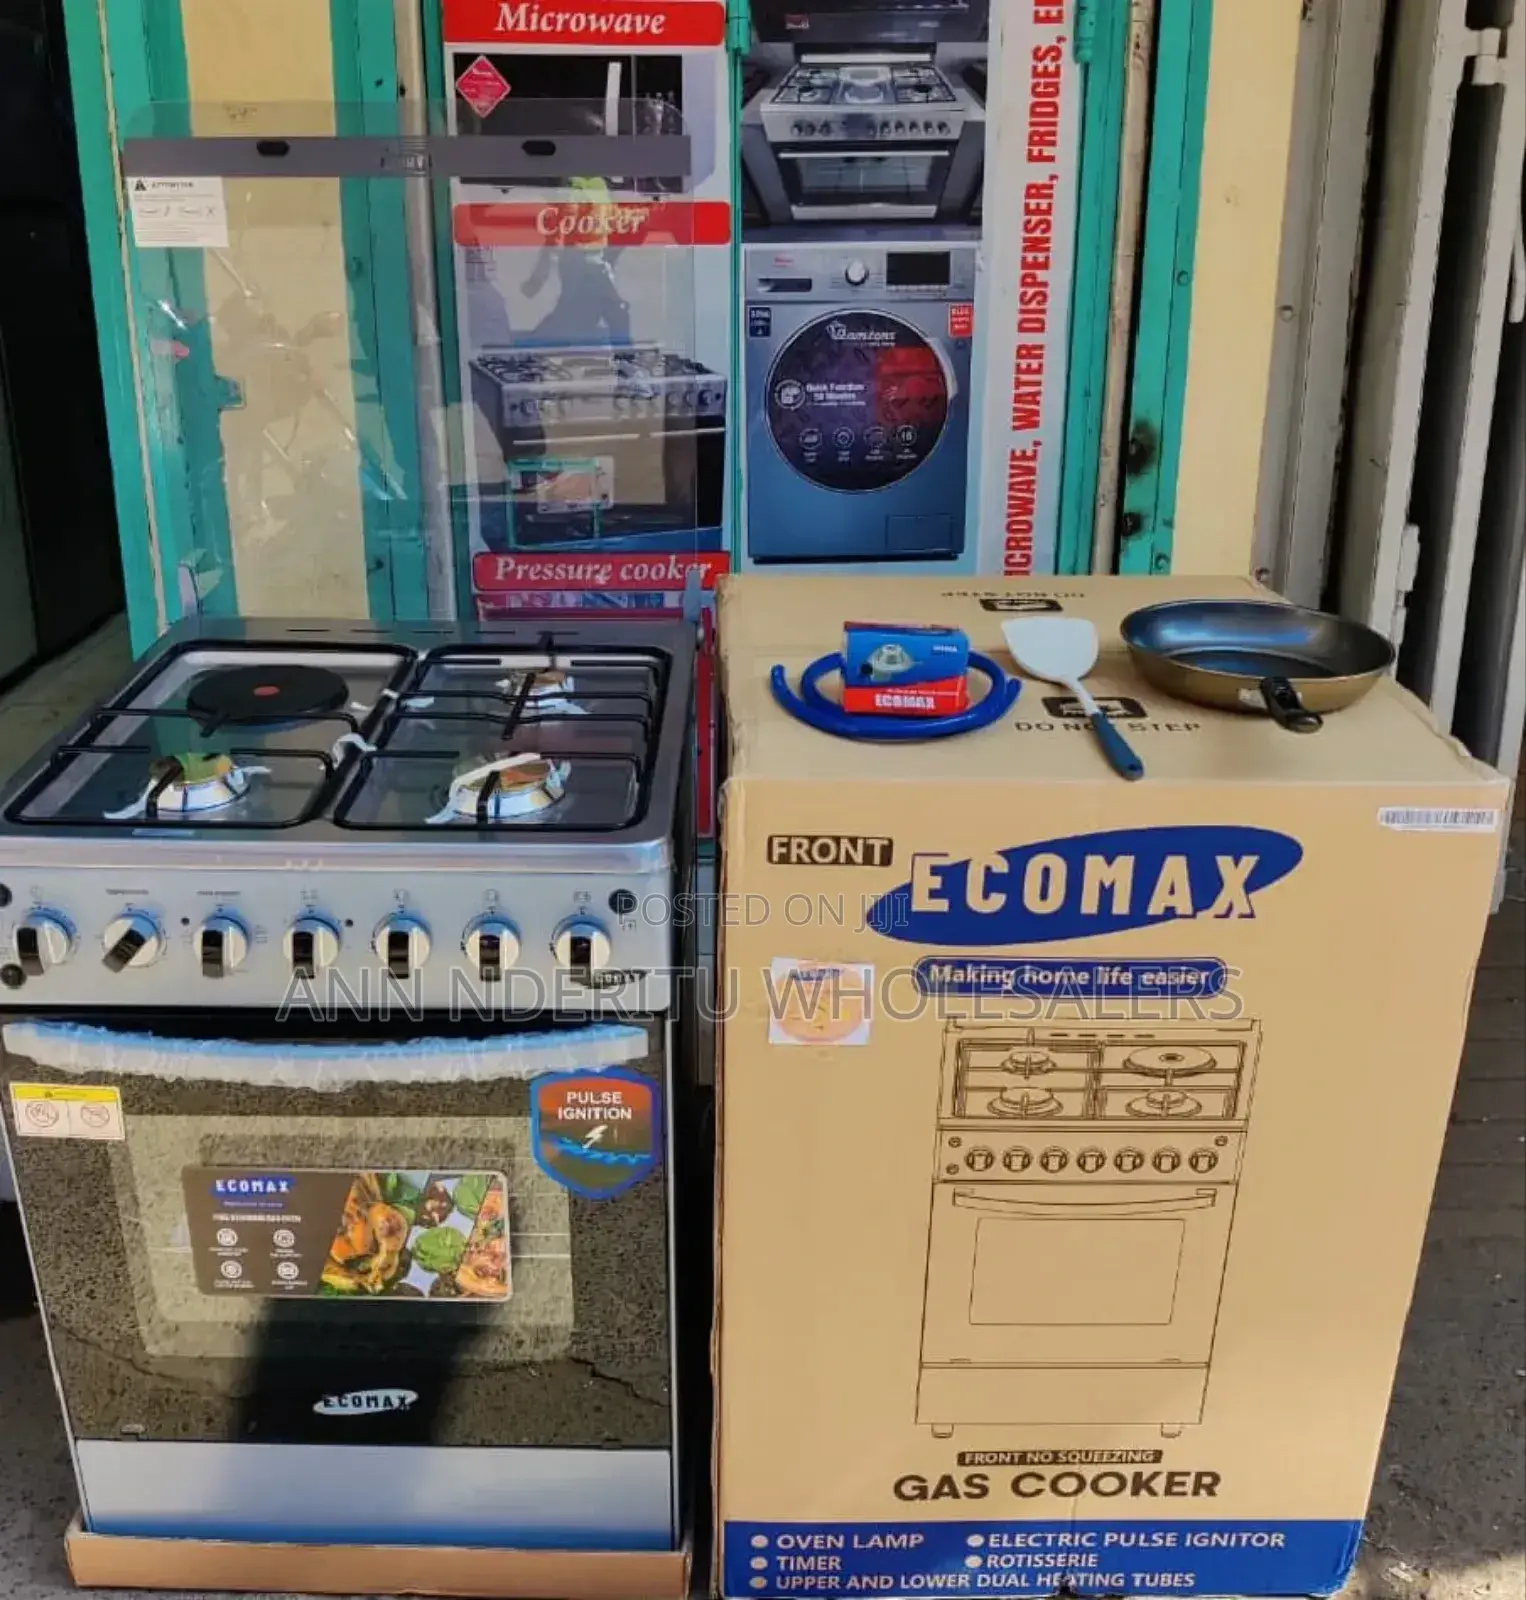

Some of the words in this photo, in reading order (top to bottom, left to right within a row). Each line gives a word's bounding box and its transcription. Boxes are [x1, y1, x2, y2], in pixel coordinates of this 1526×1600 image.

[494, 2, 667, 35] Microwave
[1026, 35, 1067, 163] FRIDGES,
[536, 207, 646, 236] Cooker
[1017, 174, 1060, 334] DISPENSER,
[1012, 344, 1045, 431] WATER
[1003, 440, 1043, 576] ICROWAVE,
[495, 556, 612, 582] Pressure
[1014, 721, 1055, 733] DO
[1127, 721, 1201, 733] STEP
[772, 836, 890, 865] FRONT
[910, 852, 1261, 919] ECOMAX
[930, 964, 1015, 989] Making
[1024, 964, 1090, 986] home
[1097, 965, 1133, 986] life
[1142, 966, 1209, 987] easier
[566, 1091, 622, 1104] PULSE
[557, 1107, 633, 1120] IGNITION
[215, 1179, 290, 1193] ECOMAX
[323, 1394, 410, 1411] ECOMAX
[964, 1451, 1021, 1464] FRONT
[1026, 1450, 1051, 1463] NO
[1058, 1450, 1154, 1463] SQUEEZING
[893, 1473, 989, 1500] GAS
[1010, 1471, 1221, 1499] COOKER
[776, 1534, 845, 1549] OVEN
[853, 1534, 924, 1548] LAMP
[989, 1533, 1099, 1547] ELECTRIC
[1103, 1532, 1178, 1547] PULSE
[1185, 1532, 1286, 1547] IGNITOR
[776, 1555, 841, 1570] TIMER
[987, 1553, 1099, 1568] ROTISSERIE
[776, 1576, 840, 1590] UPPER
[846, 1575, 893, 1589] AND
[901, 1574, 970, 1589] LOWER
[976, 1573, 1030, 1588] DUAL
[1036, 1572, 1125, 1588] HEATING
[1132, 1572, 1196, 1587] TUBES
